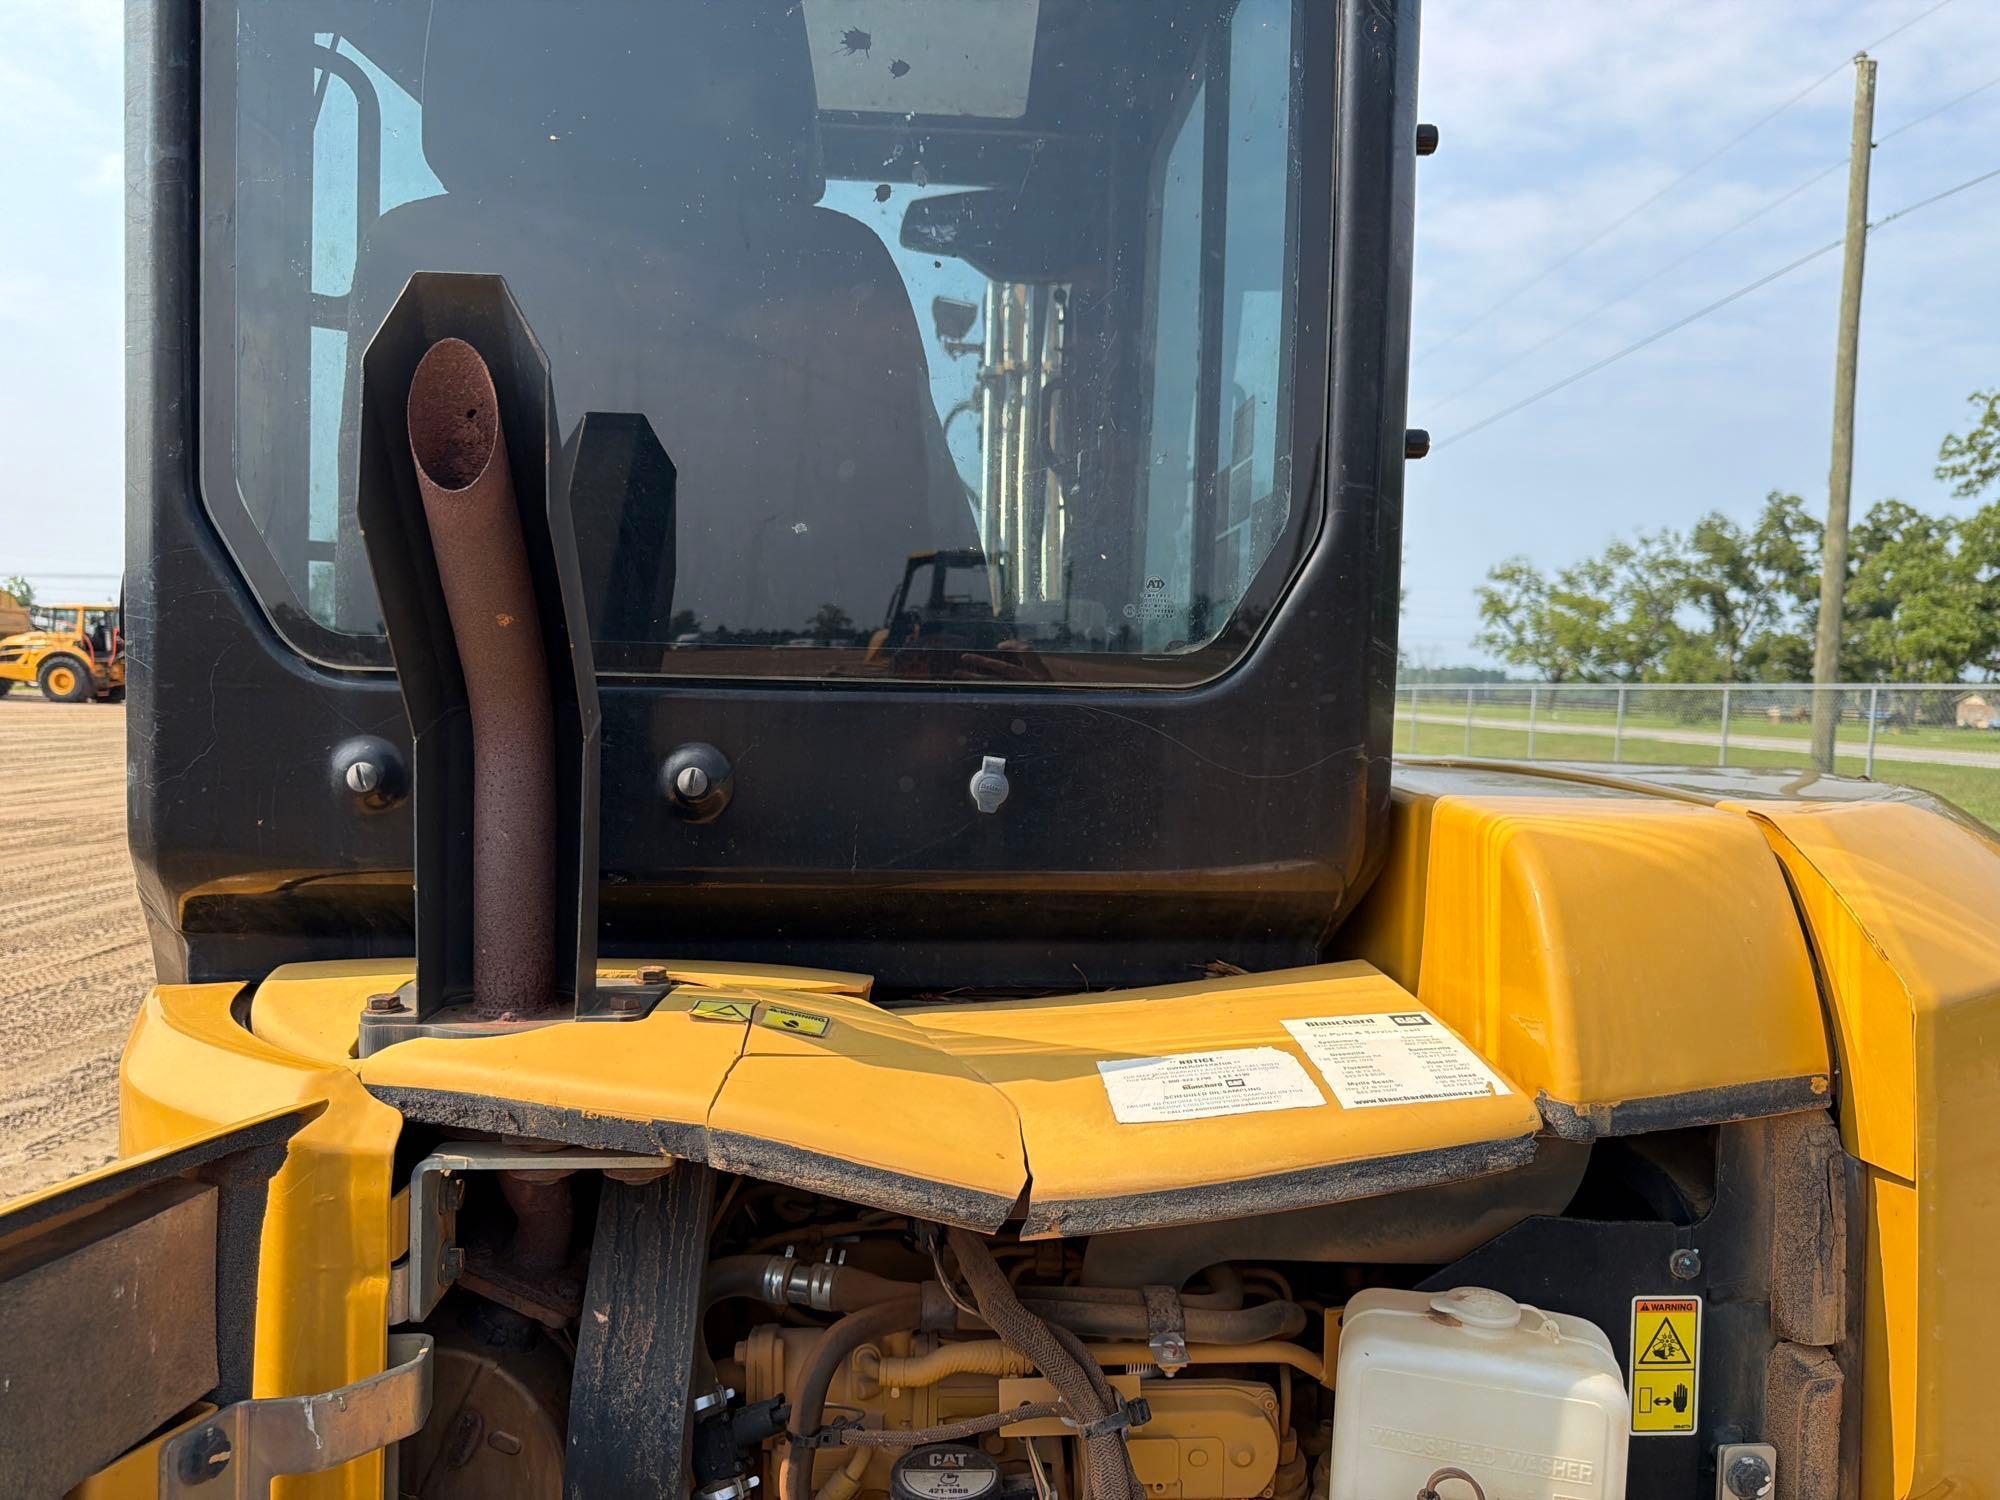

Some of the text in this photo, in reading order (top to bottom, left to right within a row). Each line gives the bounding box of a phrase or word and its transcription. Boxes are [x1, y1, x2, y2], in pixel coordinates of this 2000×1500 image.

[780, 1010, 826, 1022] WARNING
[1305, 1018, 1374, 1027] Blanchard
[1178, 1057, 1214, 1065] NOTICE
[1182, 1082, 1223, 1090] Blanchard
[1651, 1303, 1693, 1311] WARNING
[929, 1453, 967, 1467] CAT
[1505, 1452, 1593, 1481] WASHER
